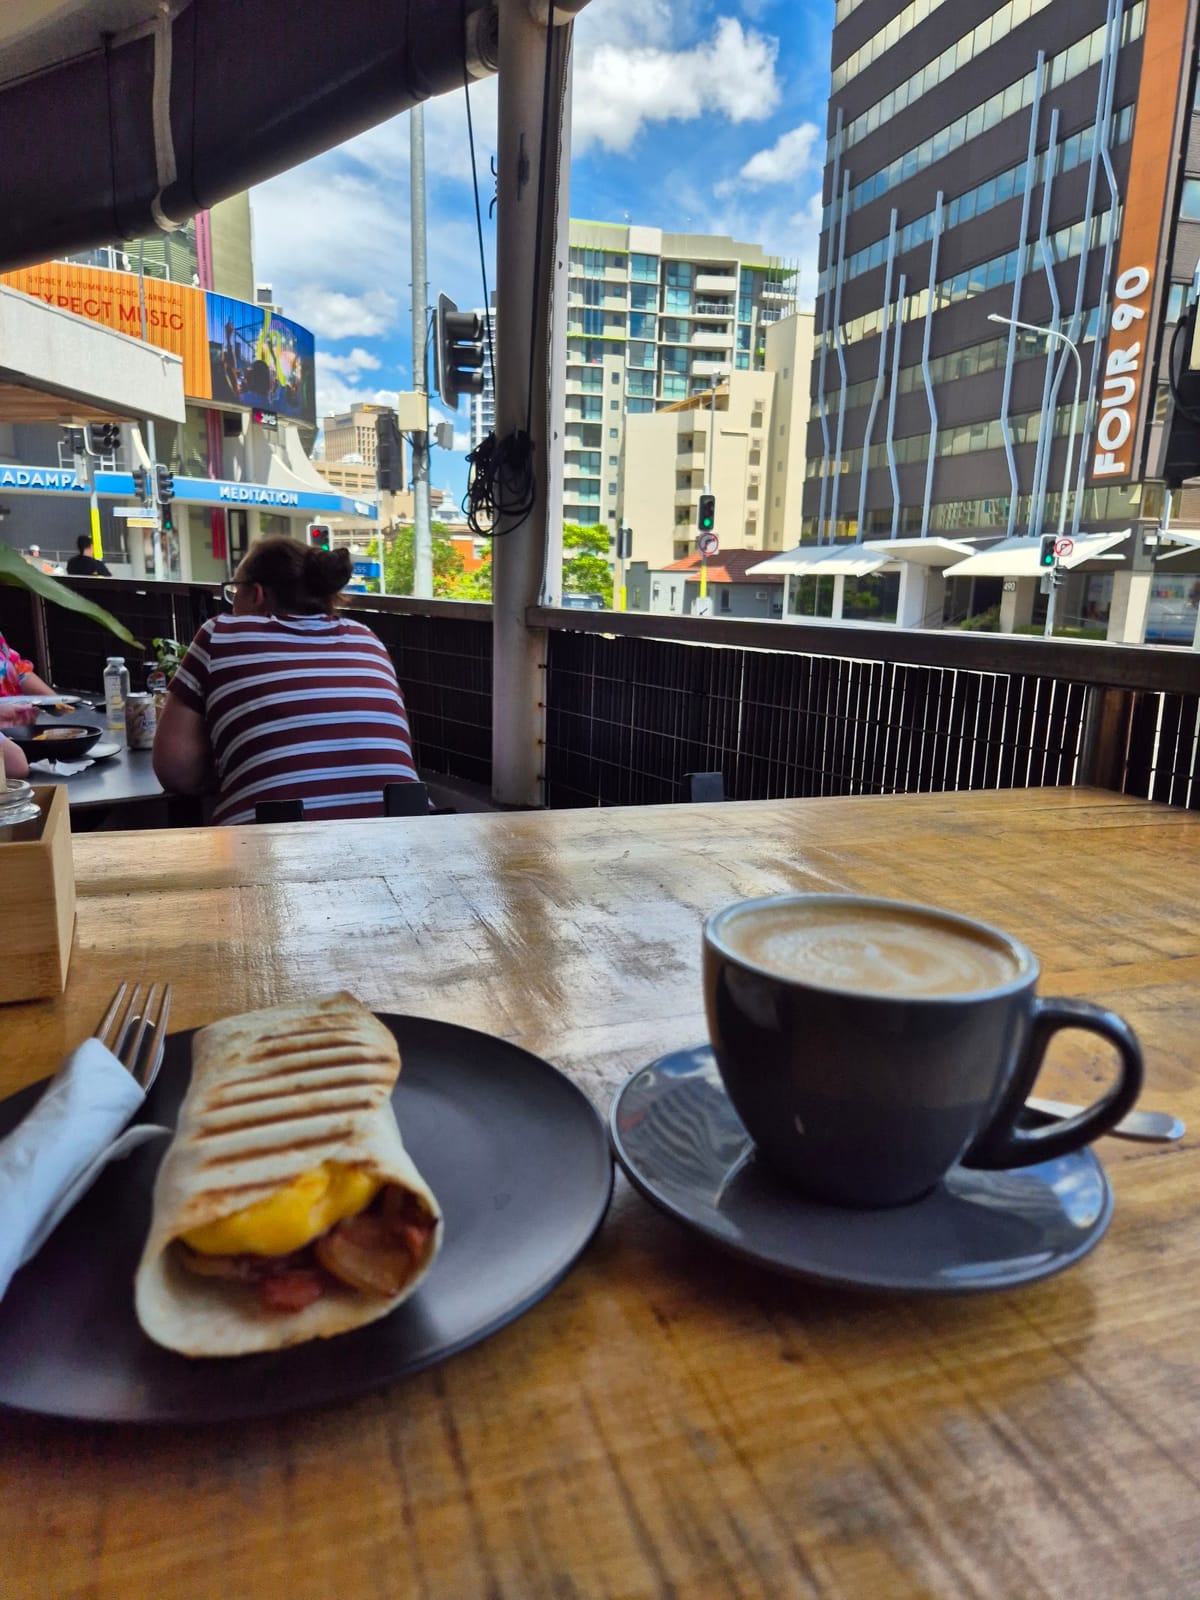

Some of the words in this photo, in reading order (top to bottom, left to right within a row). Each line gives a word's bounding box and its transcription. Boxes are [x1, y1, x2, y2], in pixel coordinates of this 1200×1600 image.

[65, 280, 101, 292] AUTUMN
[1111, 266, 1150, 331] 90
[29, 292, 112, 318] XPECT
[118, 303, 184, 331] MUSIC
[1093, 341, 1141, 475] FOUR
[219, 486, 298, 505] MEDITATION
